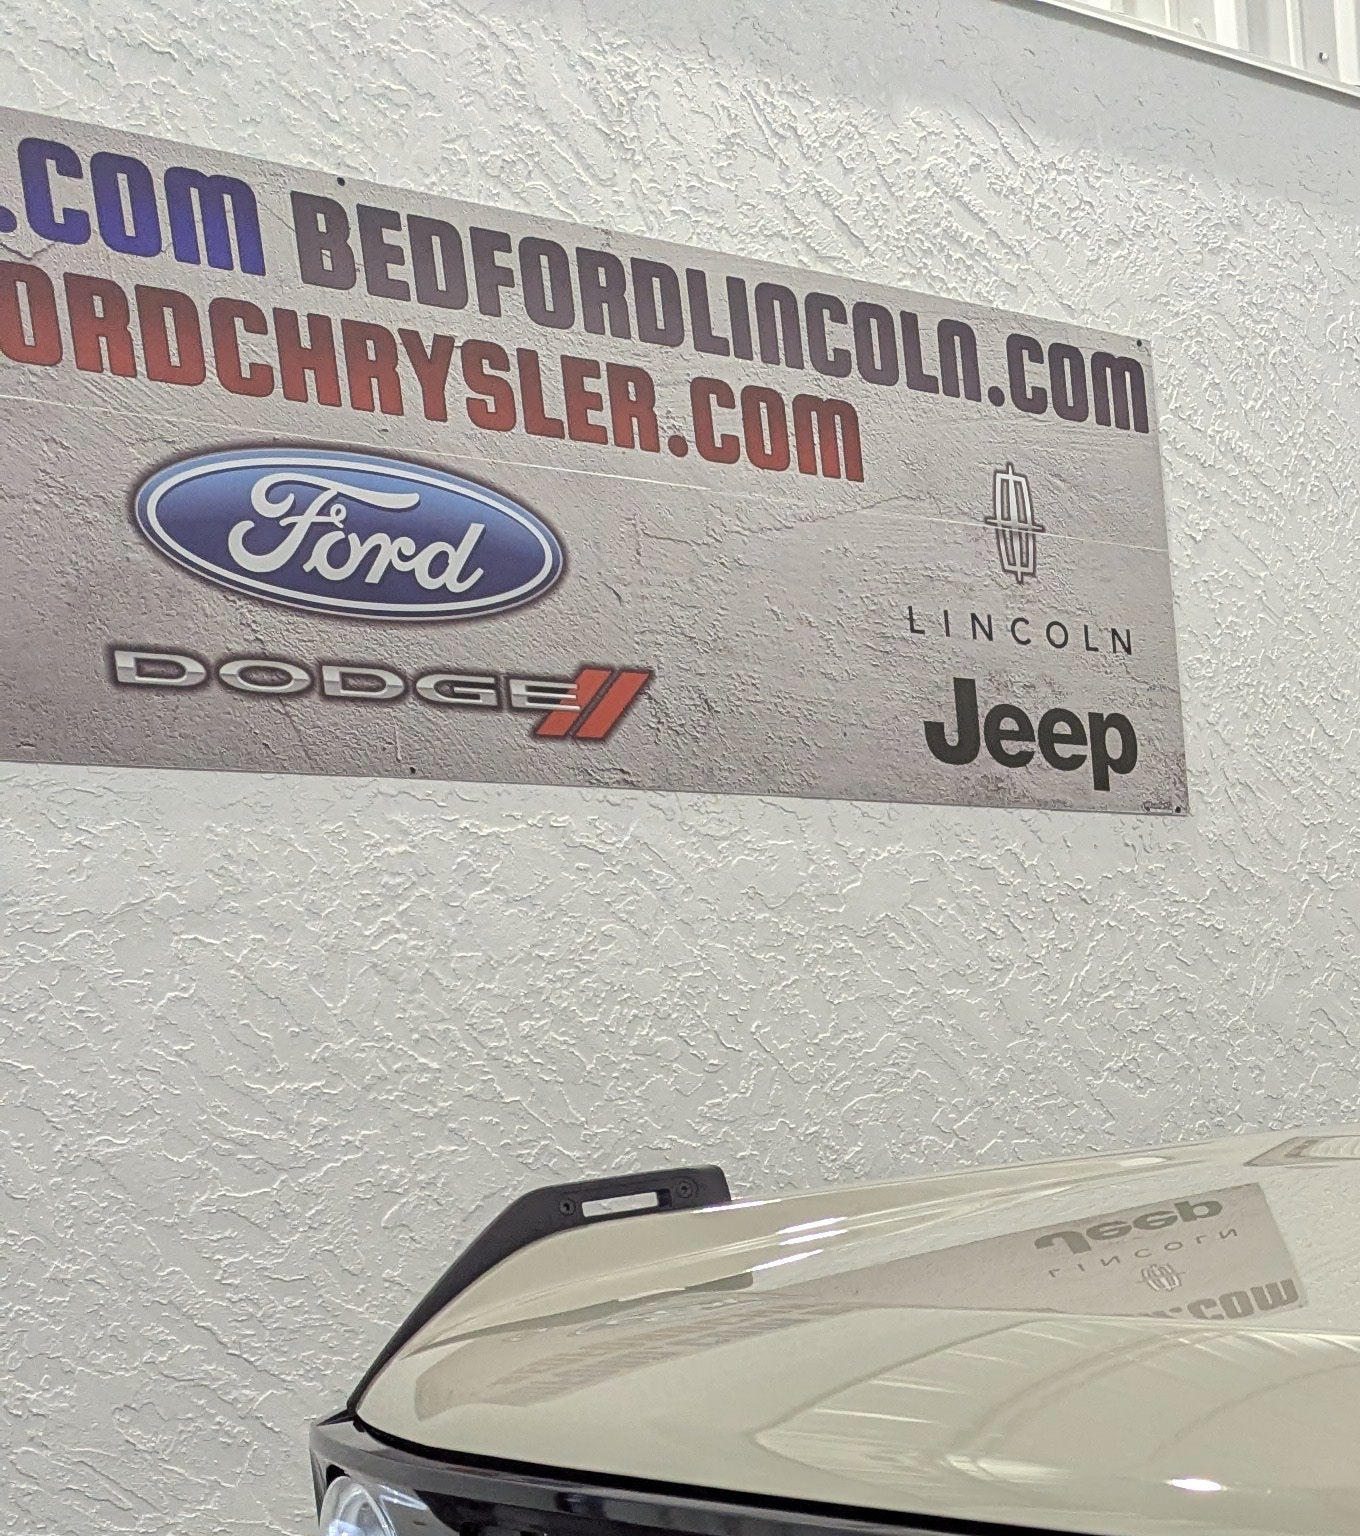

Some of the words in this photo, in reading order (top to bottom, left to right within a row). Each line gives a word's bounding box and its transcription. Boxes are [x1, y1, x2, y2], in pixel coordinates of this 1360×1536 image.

[228, 472, 486, 594] Ford
[908, 605, 1133, 655] LINCOLN
[114, 649, 581, 713] DODGE
[923, 676, 1138, 792] Jeep
